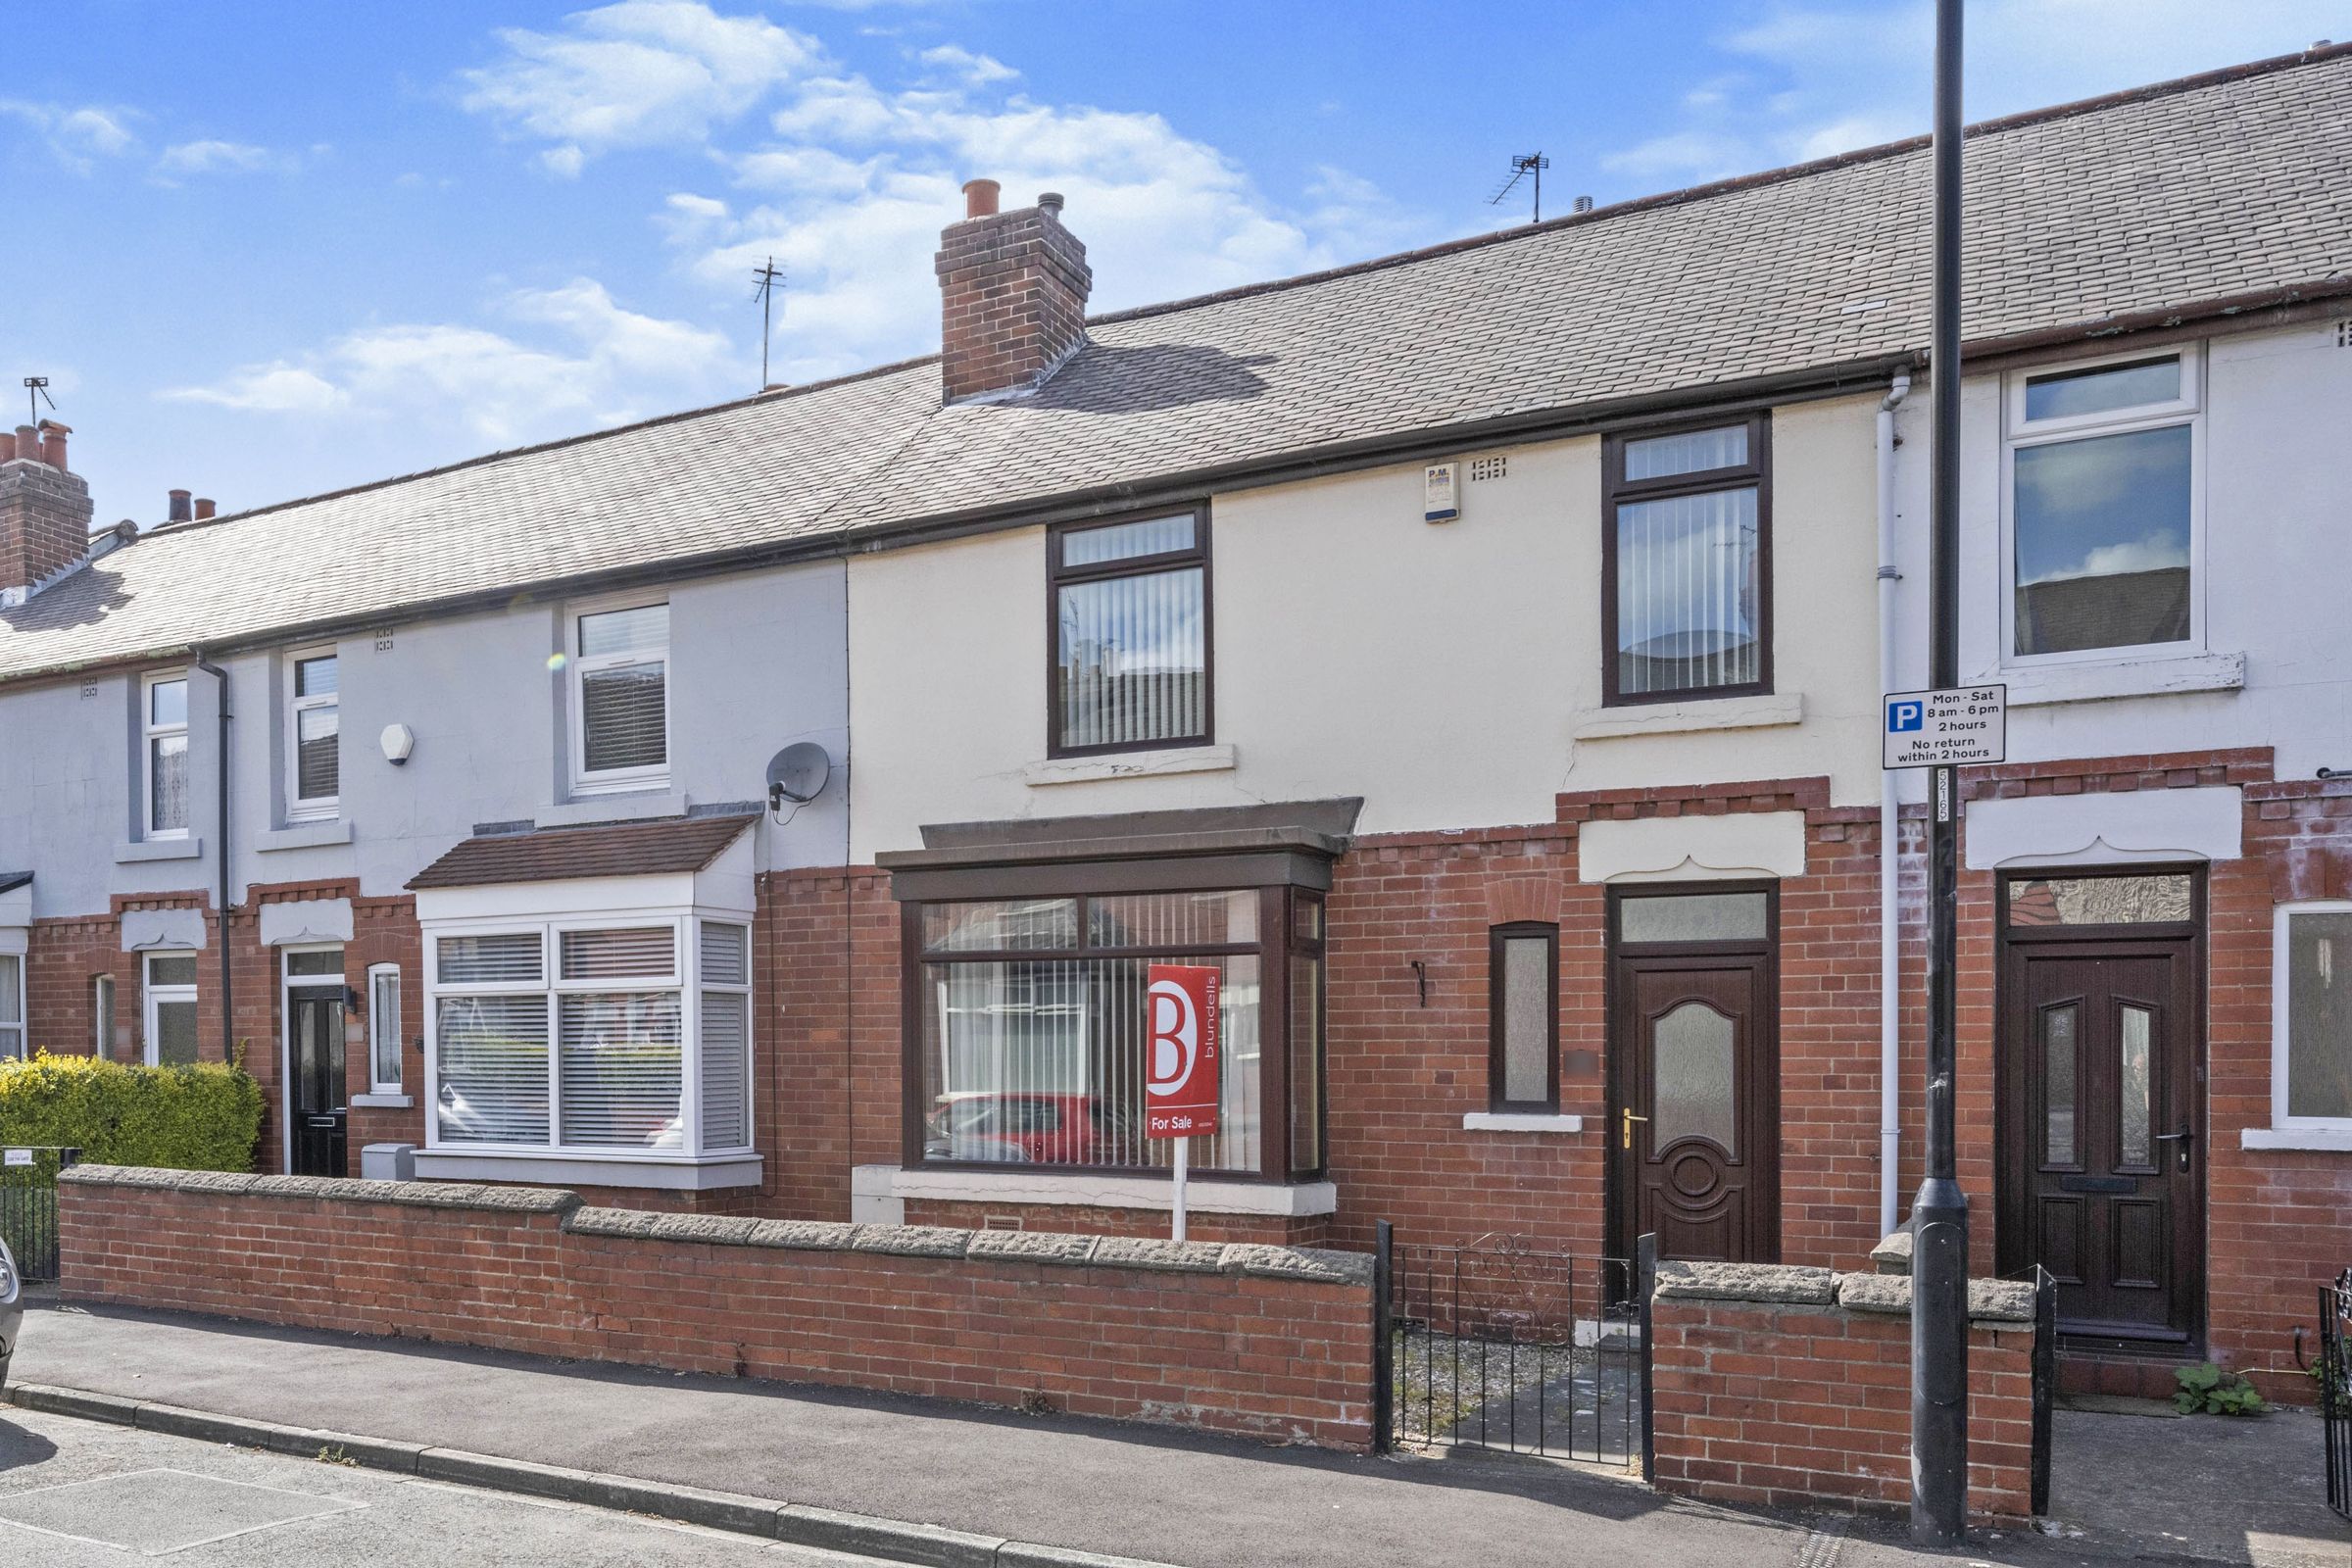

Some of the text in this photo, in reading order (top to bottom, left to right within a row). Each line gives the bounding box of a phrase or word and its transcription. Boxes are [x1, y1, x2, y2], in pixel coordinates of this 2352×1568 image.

[1933, 694, 1960, 705] Mon
[1971, 690, 1994, 702] Sat
[1896, 705, 1918, 730] P
[1927, 709, 1936, 718] 8
[1968, 705, 1976, 715] 6
[1979, 706, 1999, 716] pm
[1938, 721, 1986, 732] 2 hours
[1912, 738, 1975, 750] No return
[1898, 749, 1989, 761] within 2 hours
[1938, 770, 1947, 820] 52165
[1204, 976, 1216, 1058] blundells
[1148, 992, 1188, 1085] B
[1152, 1116, 1169, 1131] For
[1171, 1115, 1193, 1130] Sale
